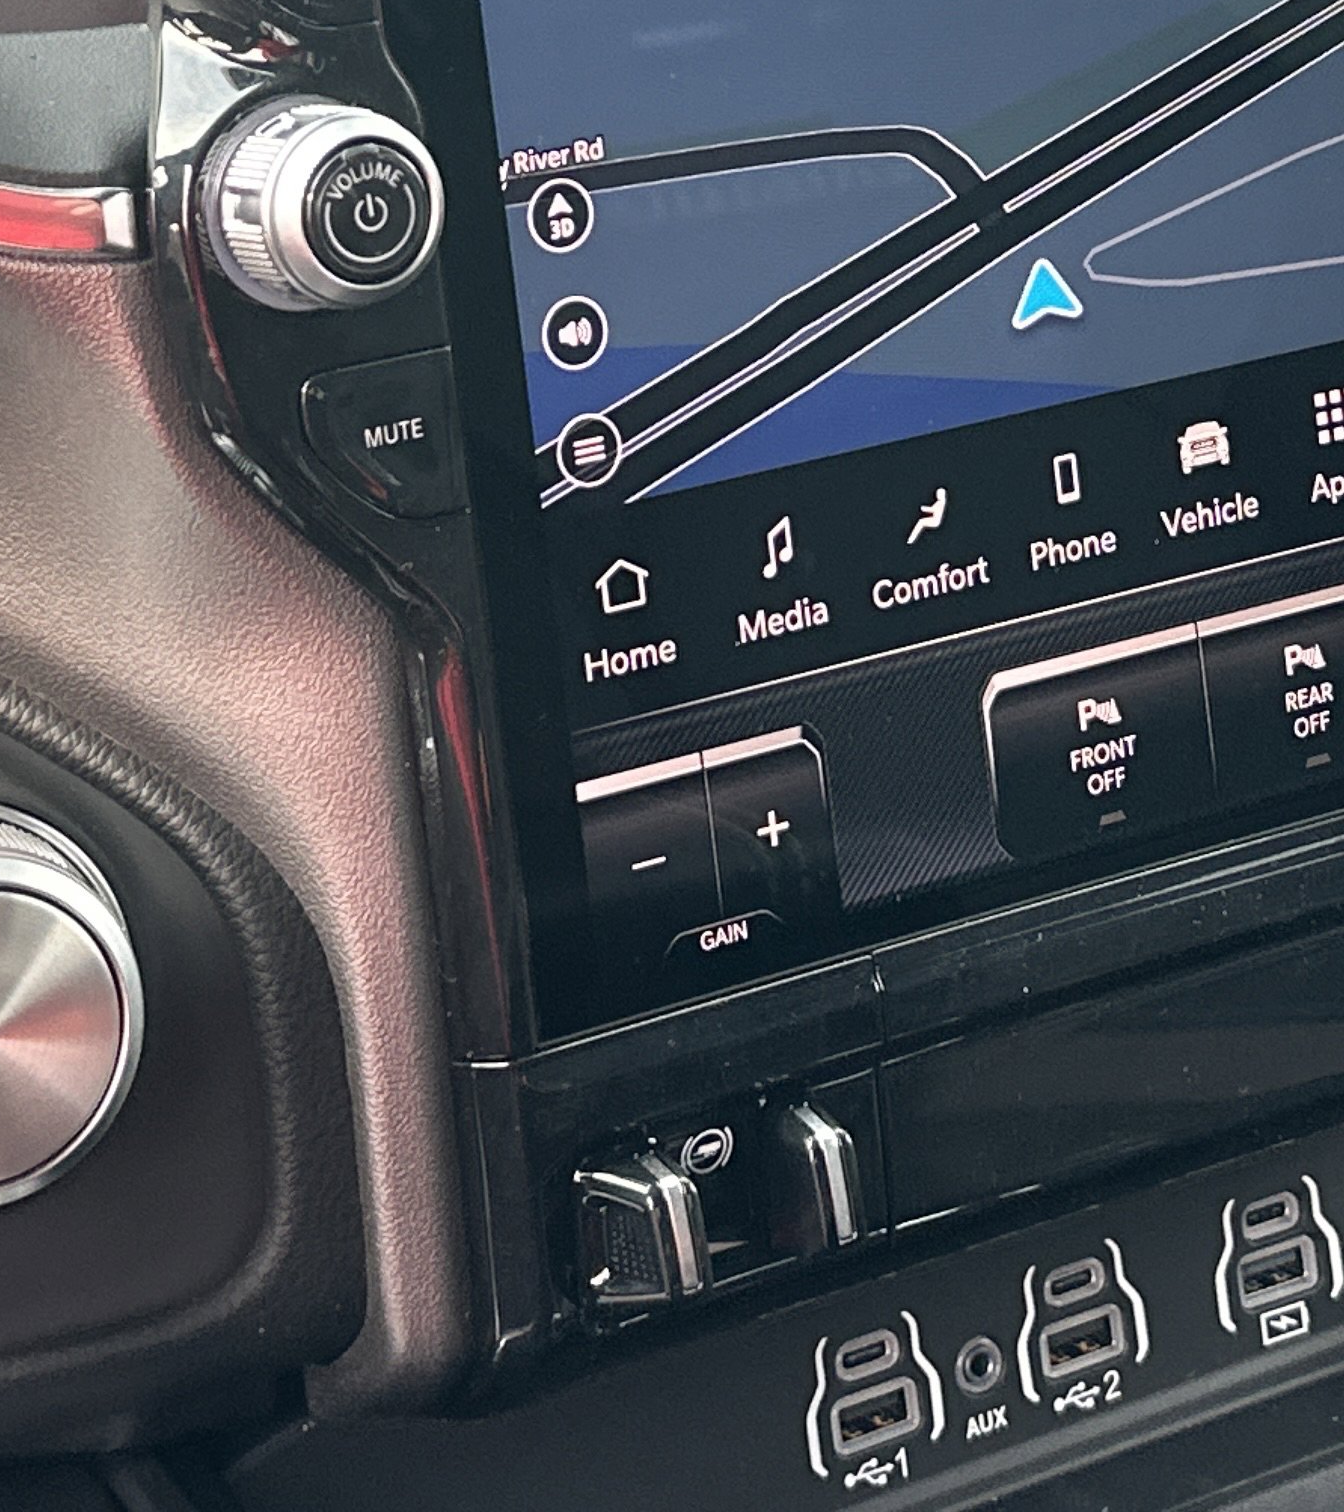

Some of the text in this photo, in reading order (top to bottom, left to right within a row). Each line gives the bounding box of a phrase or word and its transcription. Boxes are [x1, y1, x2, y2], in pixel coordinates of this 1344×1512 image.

[513, 147, 569, 174] River
[573, 136, 604, 162] Rd
[326, 162, 404, 202] VOLUME
[549, 218, 575, 240] 3D
[364, 417, 424, 449] MUTE
[1159, 492, 1260, 537] Vehicle
[1030, 531, 1117, 571] Phone
[872, 556, 991, 609] Comfort
[739, 597, 829, 642] Media
[583, 639, 677, 683] Home
[1285, 682, 1334, 713] REAR
[1293, 710, 1330, 739] OFF
[1069, 734, 1137, 772] FRONT
[1087, 766, 1126, 796] OFF
[699, 920, 749, 951] GAIN
[1102, 1369, 1122, 1401] 2
[966, 1405, 1008, 1440] AUX
[894, 1447, 909, 1478] 1
